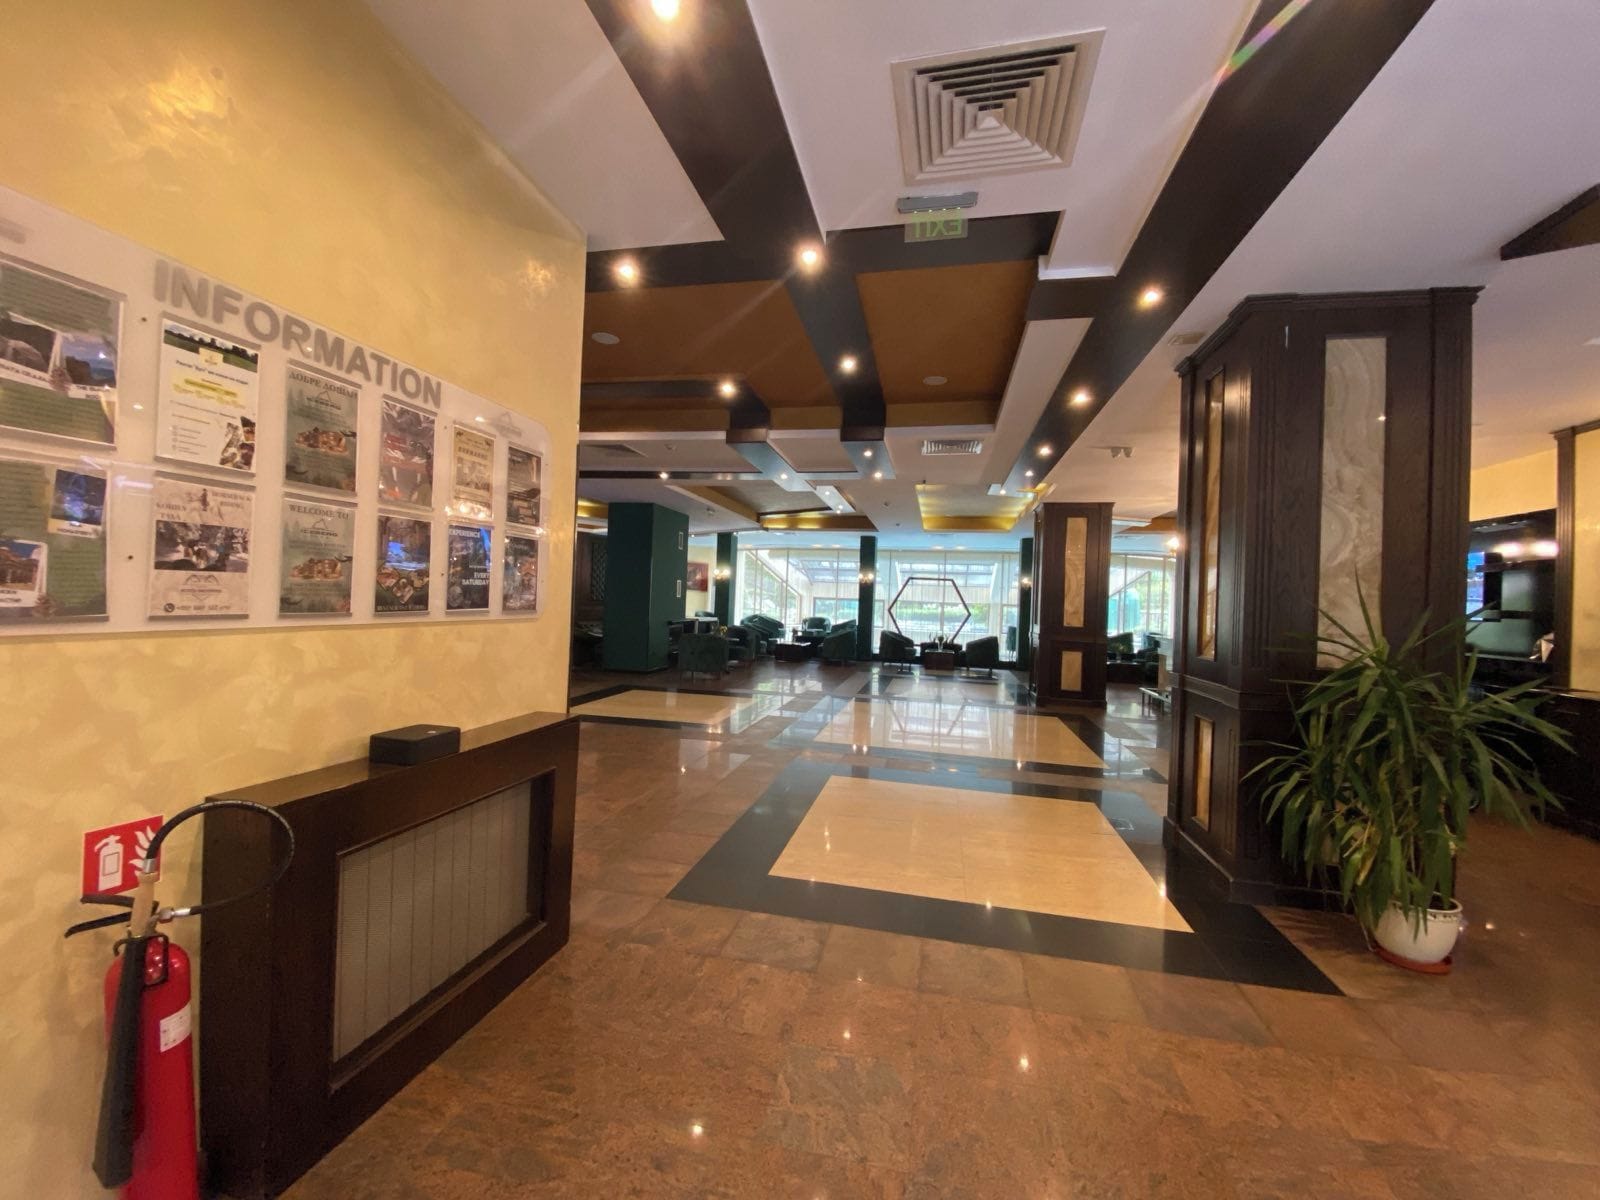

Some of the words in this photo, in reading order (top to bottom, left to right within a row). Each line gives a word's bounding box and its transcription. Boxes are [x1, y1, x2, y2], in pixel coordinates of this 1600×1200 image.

[154, 259, 442, 409] INFORMATION
[289, 504, 336, 518] WELCOME
[449, 529, 480, 538] EXPERIENCE
